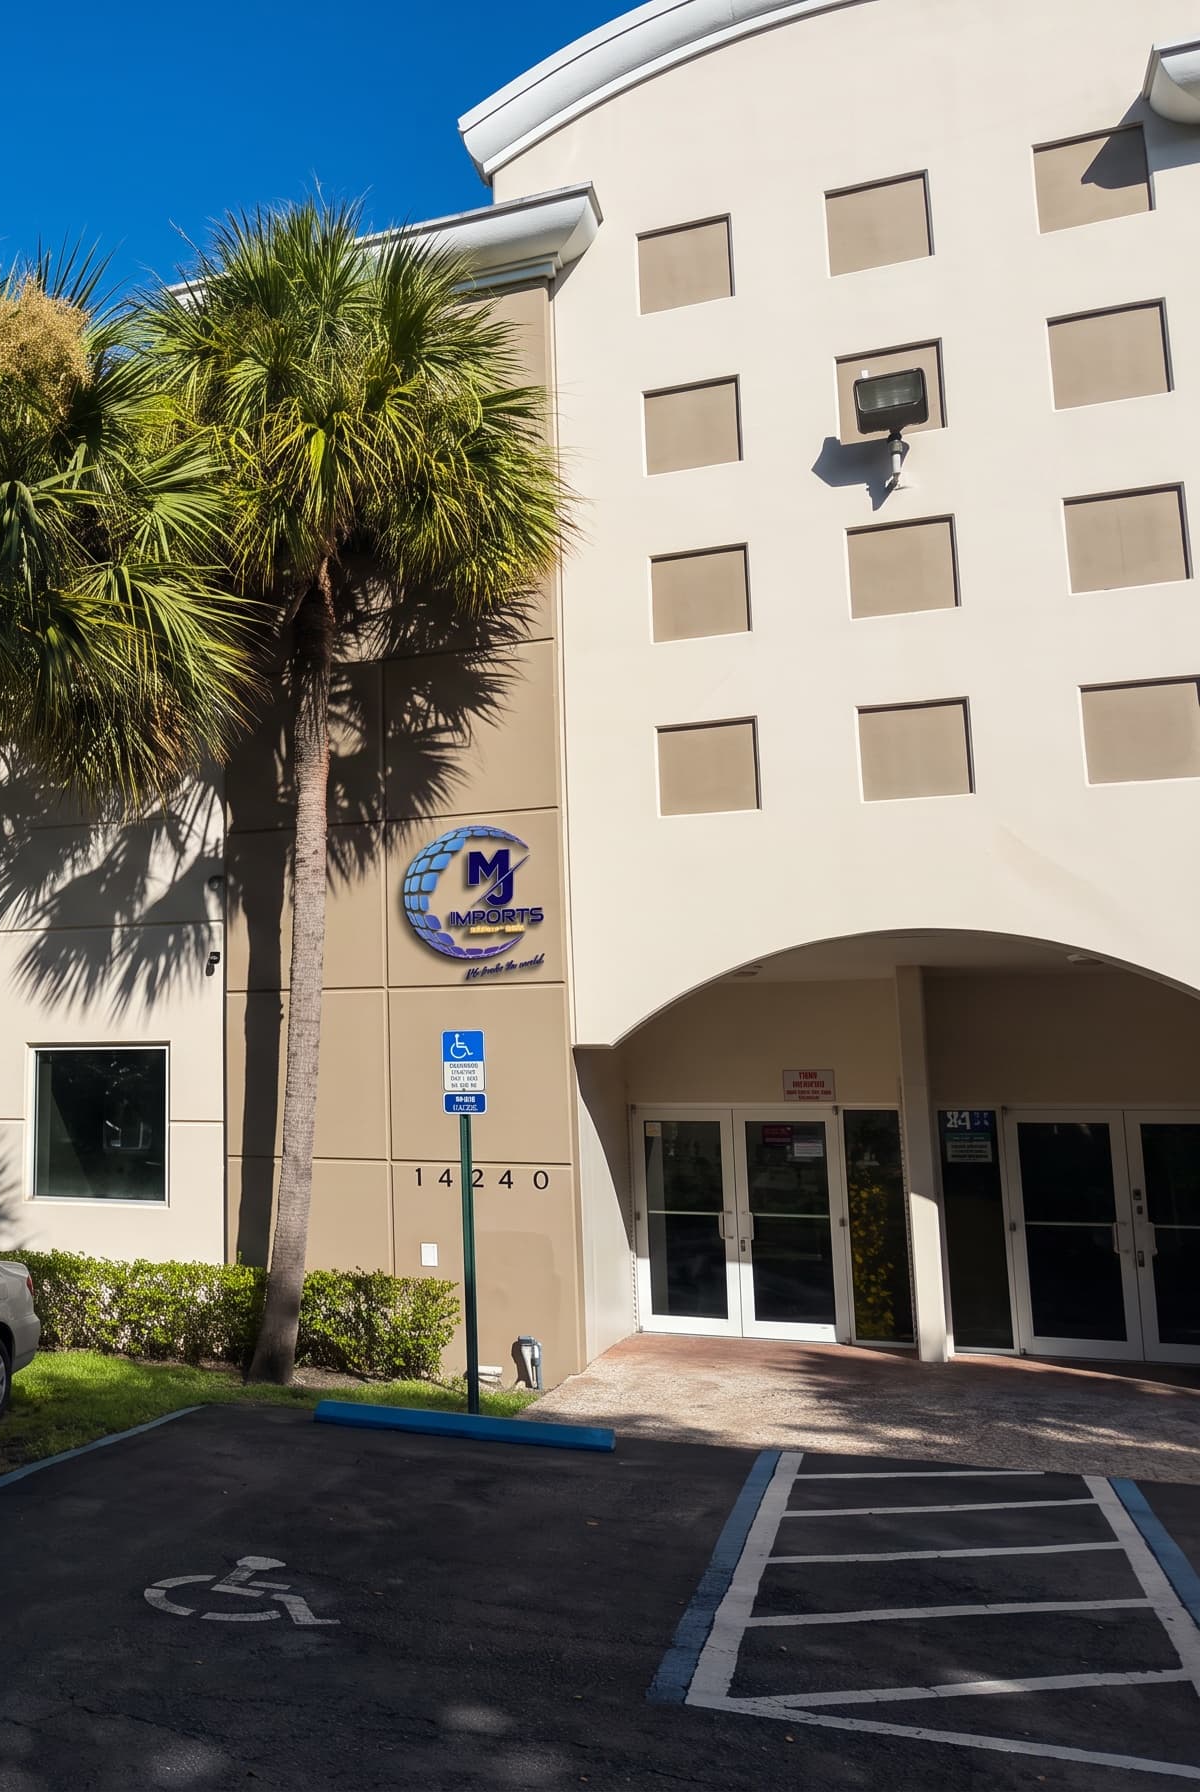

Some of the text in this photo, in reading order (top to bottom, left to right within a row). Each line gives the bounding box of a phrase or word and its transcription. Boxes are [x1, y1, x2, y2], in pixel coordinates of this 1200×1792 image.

[467, 849, 514, 906] MJ
[450, 907, 544, 926] IMPORTS
[415, 1167, 549, 1190] 14240
